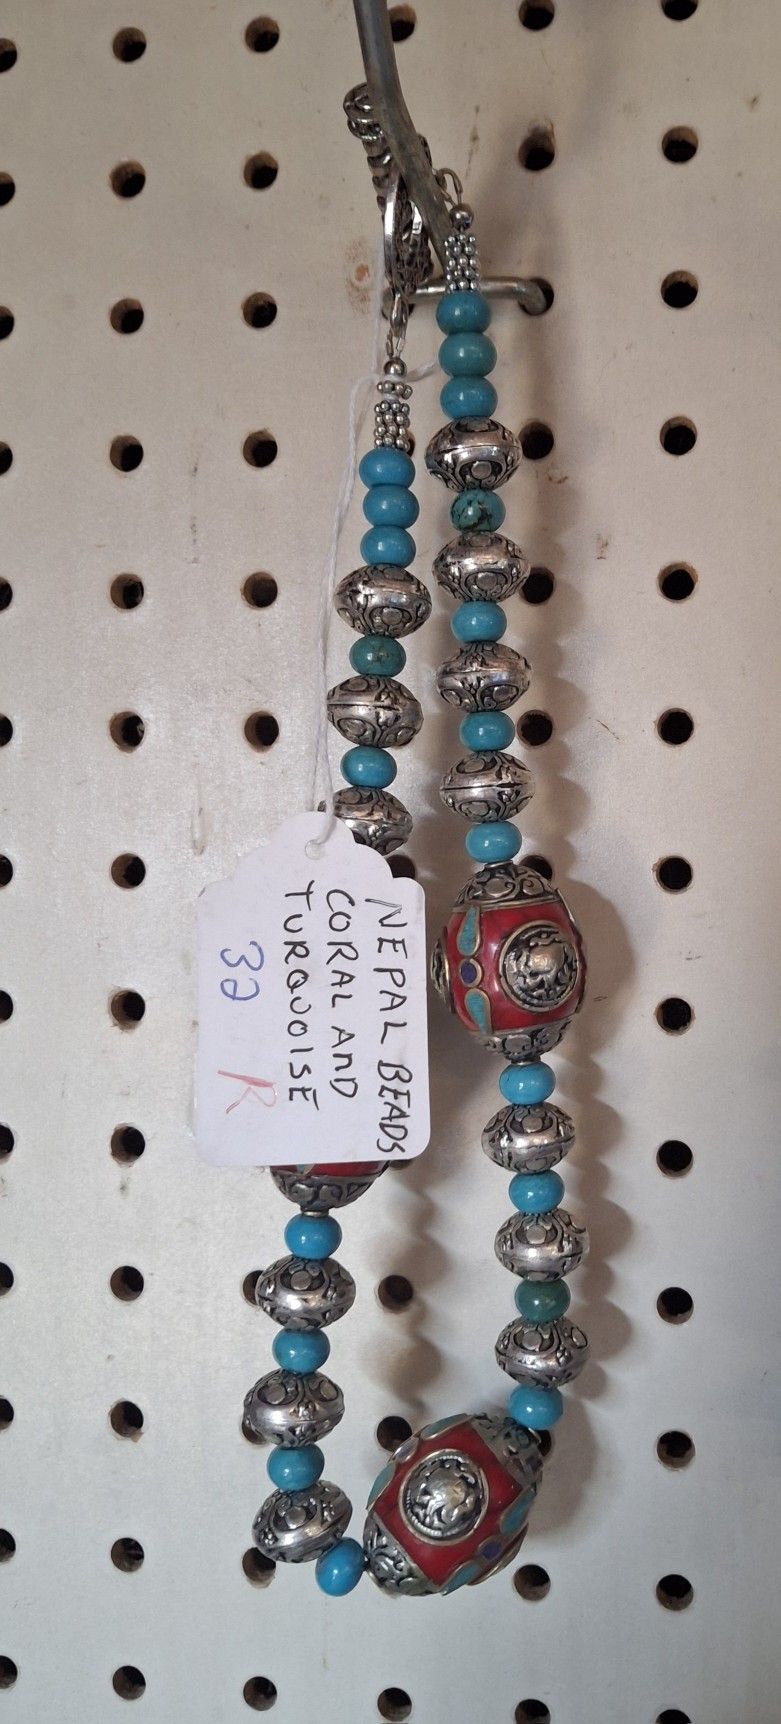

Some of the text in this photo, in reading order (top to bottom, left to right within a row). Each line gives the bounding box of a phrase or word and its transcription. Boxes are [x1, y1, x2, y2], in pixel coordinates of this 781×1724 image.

[283, 880, 319, 1111] TURQUOISE
[326, 888, 360, 1008] CORAL
[364, 897, 413, 1153] NEPAL BEADS
